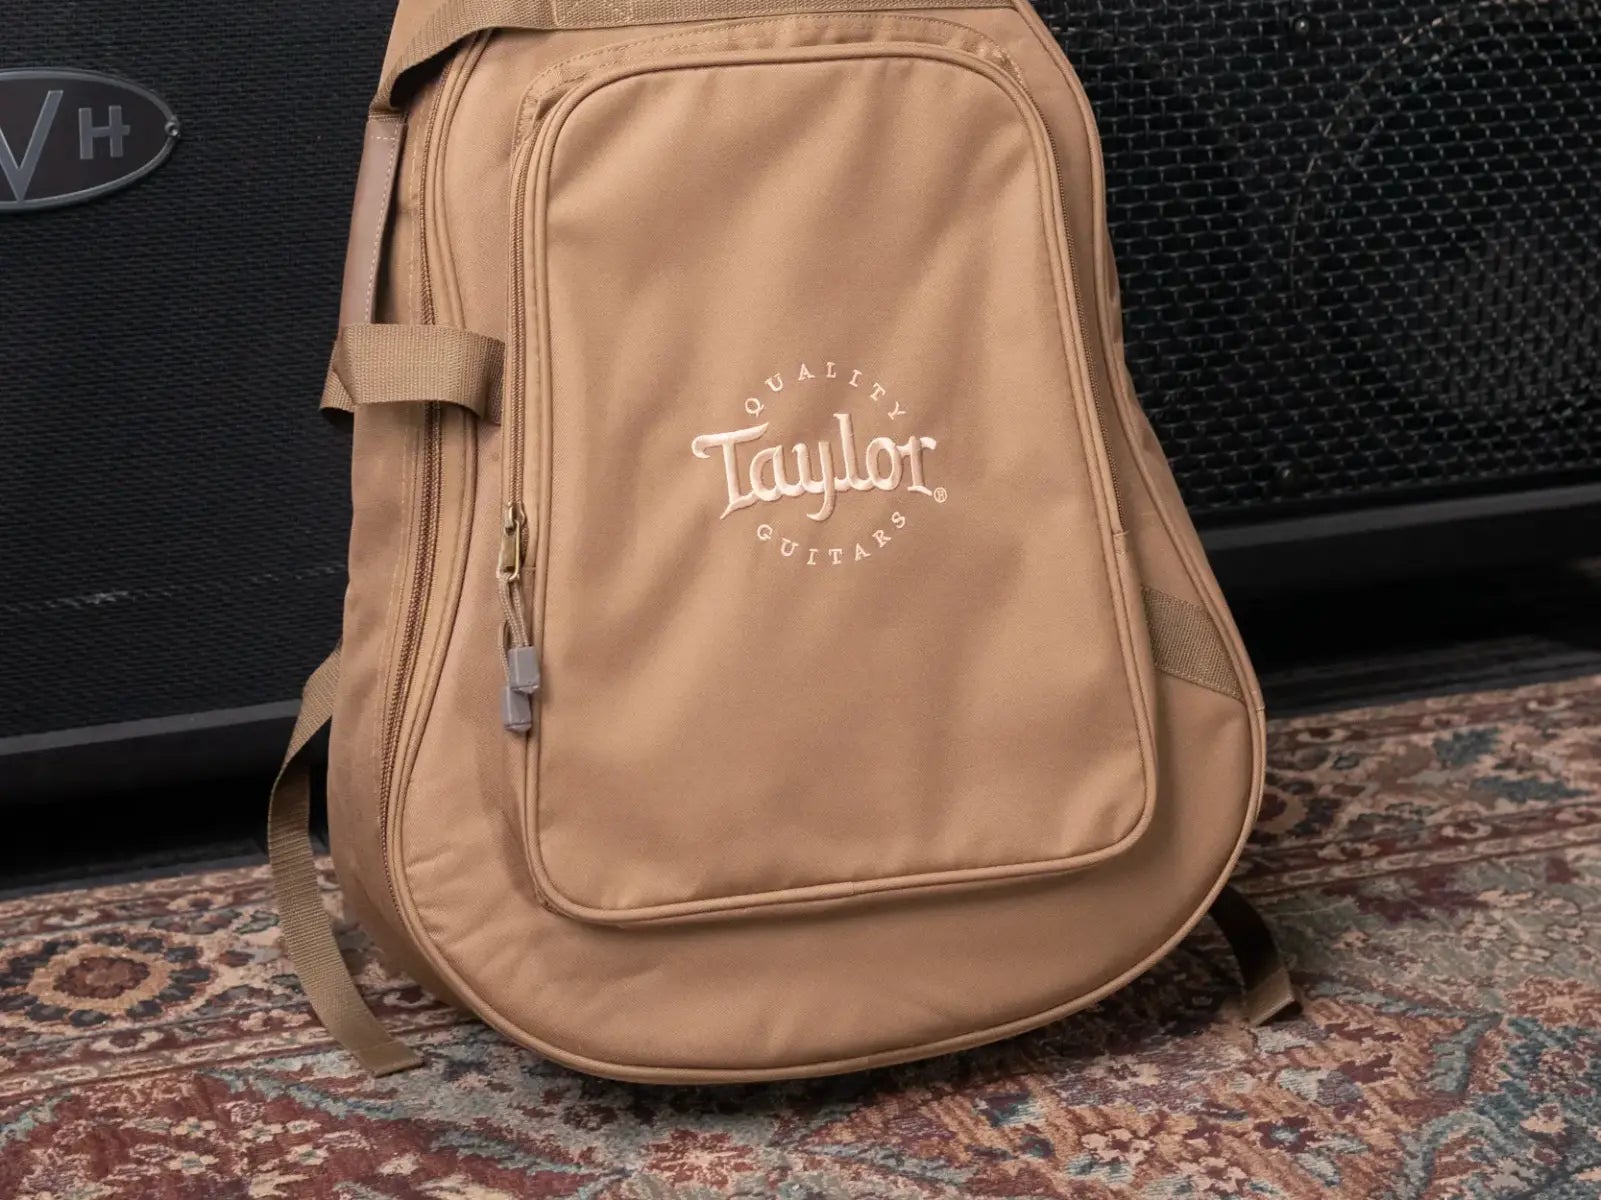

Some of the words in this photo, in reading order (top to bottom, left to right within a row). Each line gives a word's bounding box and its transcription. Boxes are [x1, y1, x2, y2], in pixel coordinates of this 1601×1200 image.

[744, 361, 906, 421] QUALITY
[691, 413, 937, 521] Taylor
[756, 510, 906, 566] GUITARS
